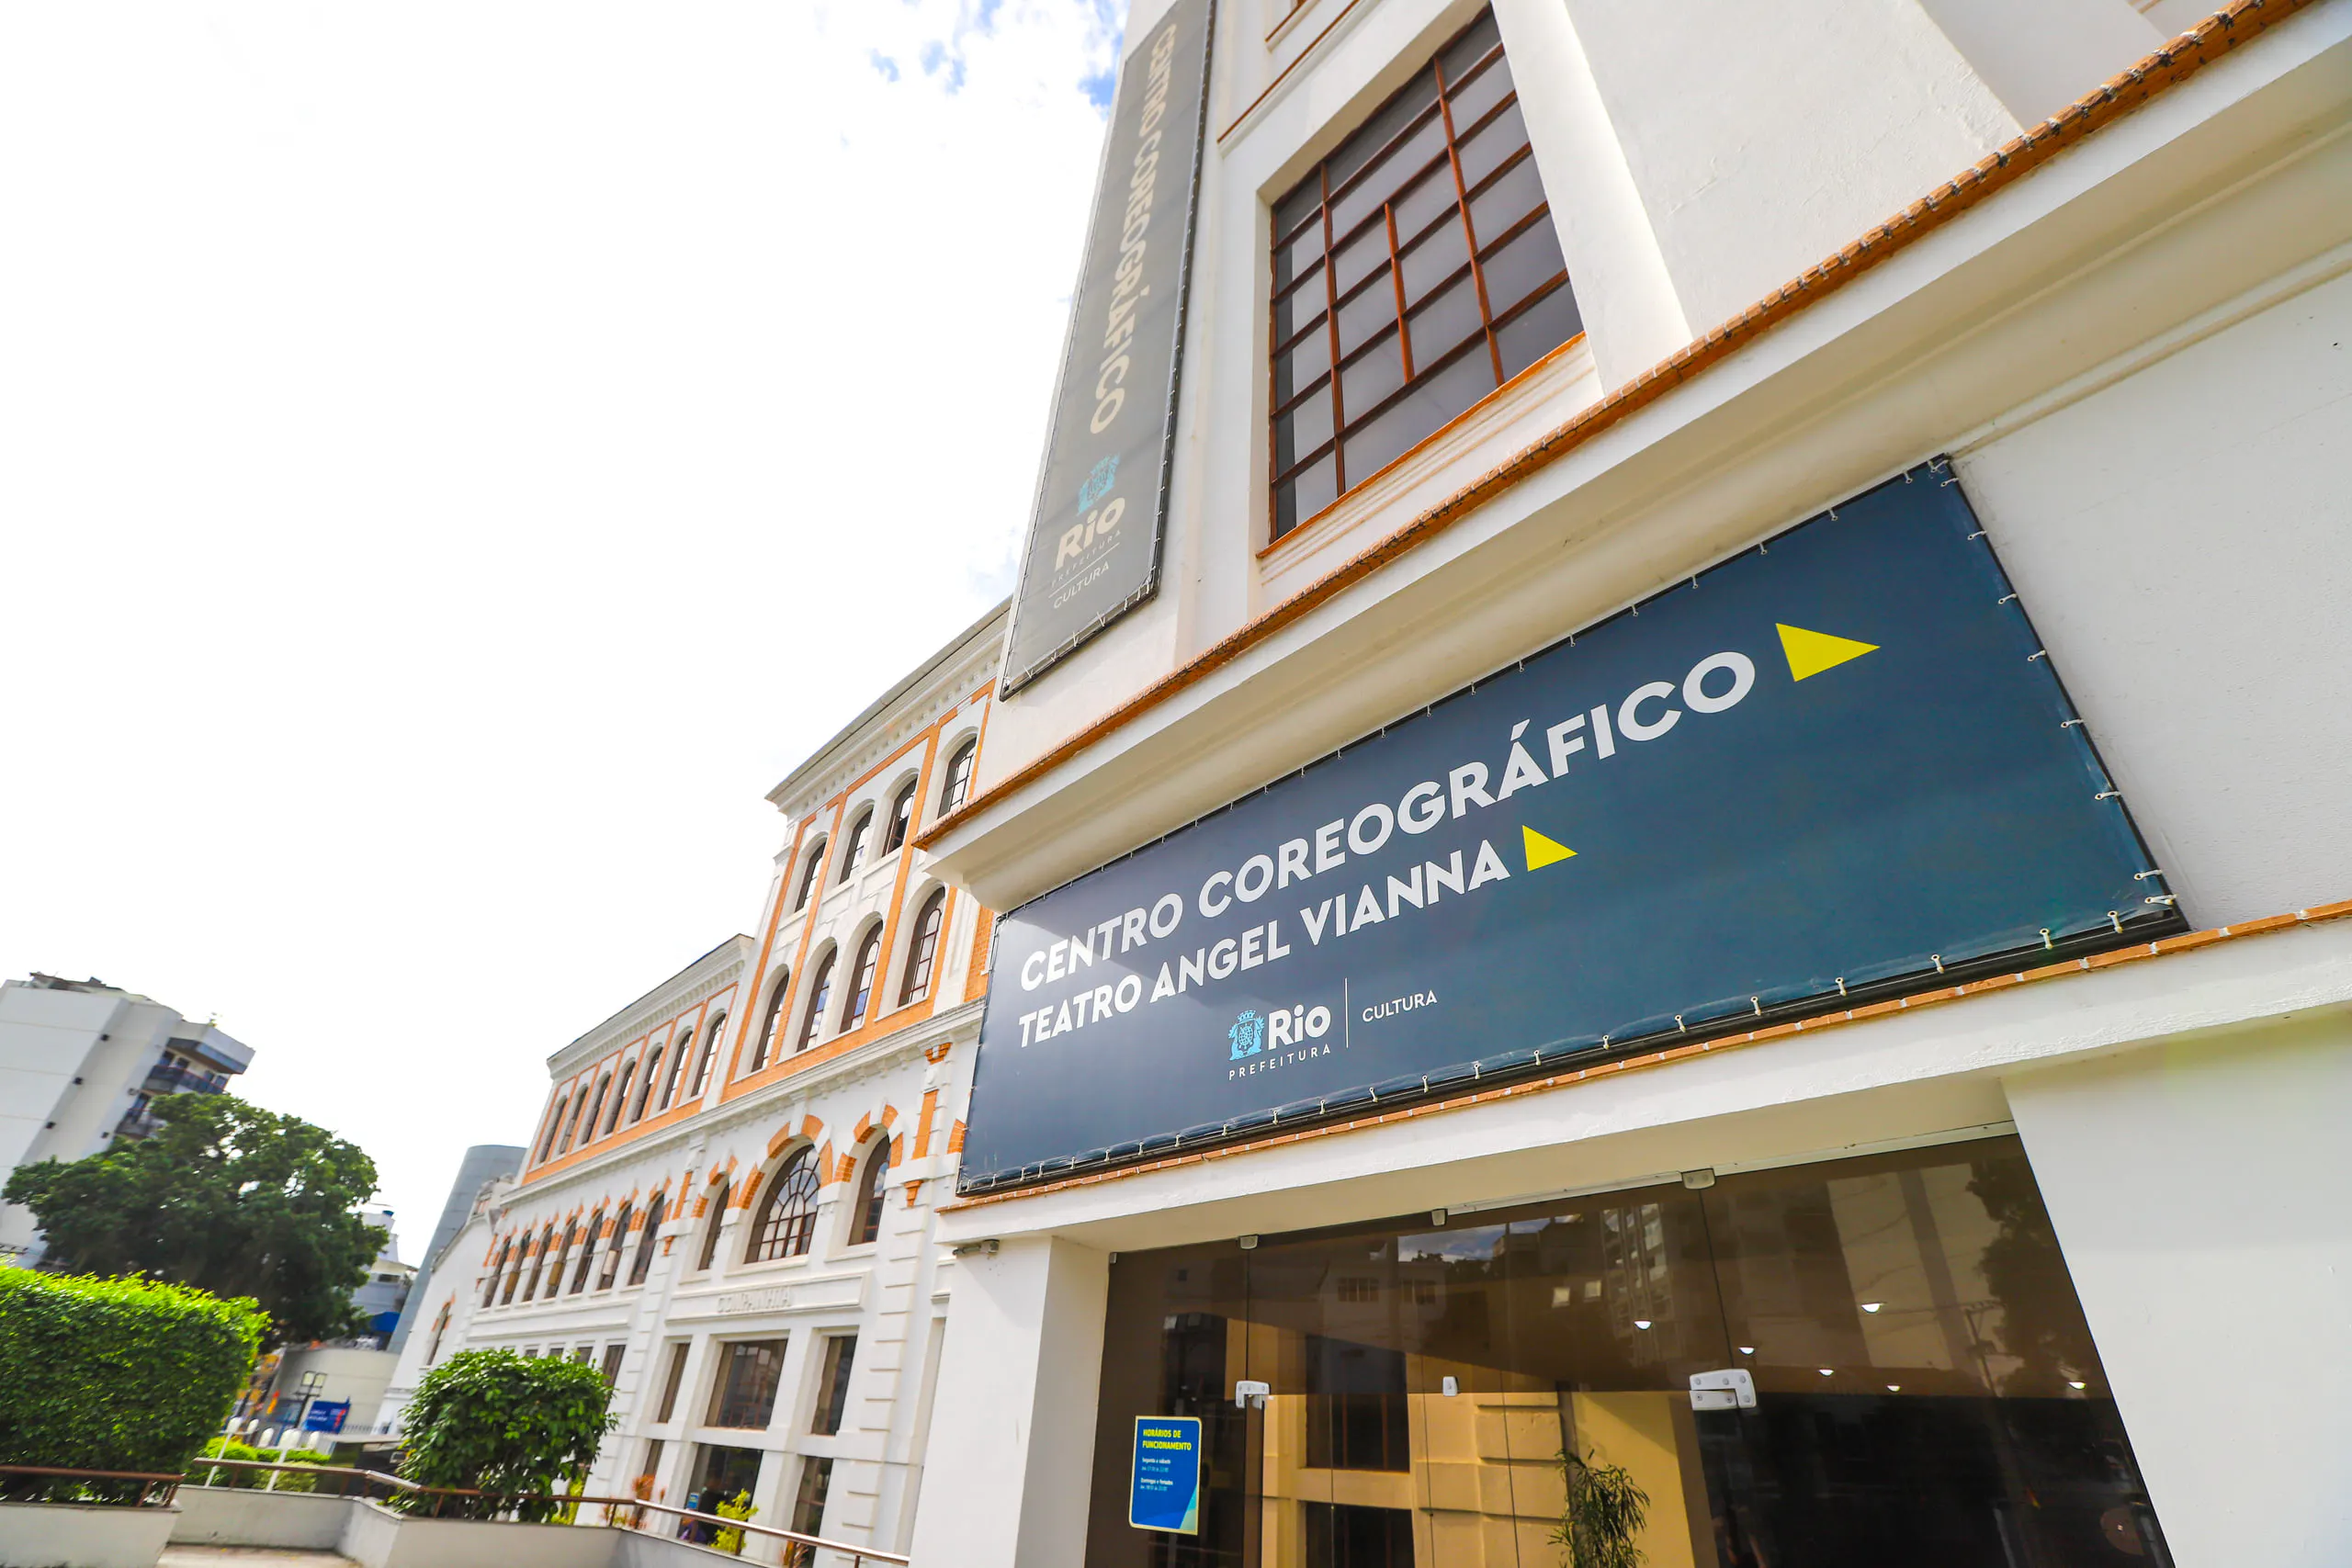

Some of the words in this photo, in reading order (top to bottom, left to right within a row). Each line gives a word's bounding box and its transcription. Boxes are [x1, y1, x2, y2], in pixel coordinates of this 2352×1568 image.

[1138, 23, 1177, 138] CENTRO
[1090, 130, 1162, 434] COREOGRÁFICO
[1055, 497, 1125, 571] Rio
[1054, 560, 1109, 609] CULTURA
[1021, 893, 1183, 991] CENTRO
[1198, 651, 1756, 918] COREOGRÁFICO
[1018, 975, 1142, 1047] TEATRO
[1149, 919, 1290, 1003] ANGEL
[1299, 839, 1511, 945] VIANNA
[1268, 1004, 1331, 1050] Rio
[1362, 989, 1438, 1022] CULTURA
[1228, 1043, 1331, 1081] PREFEITURA
[1142, 1440, 1192, 1451] FUNCIONAMENTO
[1143, 1427, 1171, 1438] HORÁRIOS
[1172, 1429, 1182, 1438] DE
